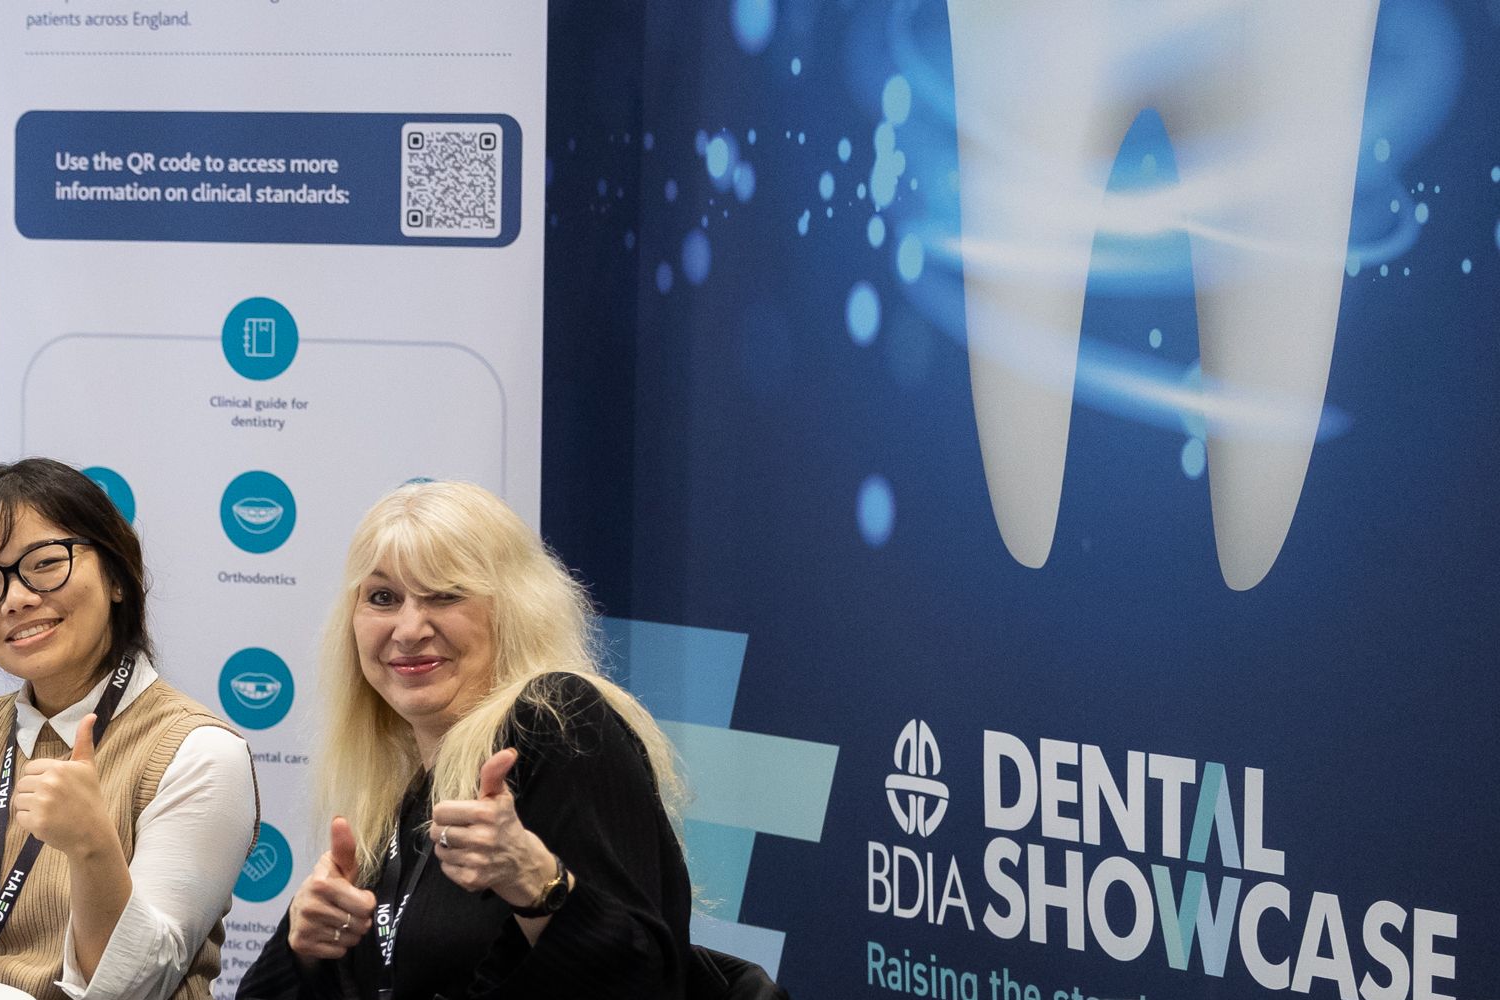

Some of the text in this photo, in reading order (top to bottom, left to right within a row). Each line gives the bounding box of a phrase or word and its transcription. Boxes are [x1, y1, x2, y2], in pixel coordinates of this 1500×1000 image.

[26, 12, 191, 30] patients across England.
[56, 152, 339, 175] Use the QR code to access more
[56, 181, 350, 205] information on clinical standards:
[209, 396, 309, 411] Clinical guide for
[231, 416, 286, 431] dentistry
[217, 571, 296, 587] Orthodontics
[252, 750, 282, 764] ental
[983, 729, 1286, 876] DENTAL
[866, 840, 975, 932] BDIA
